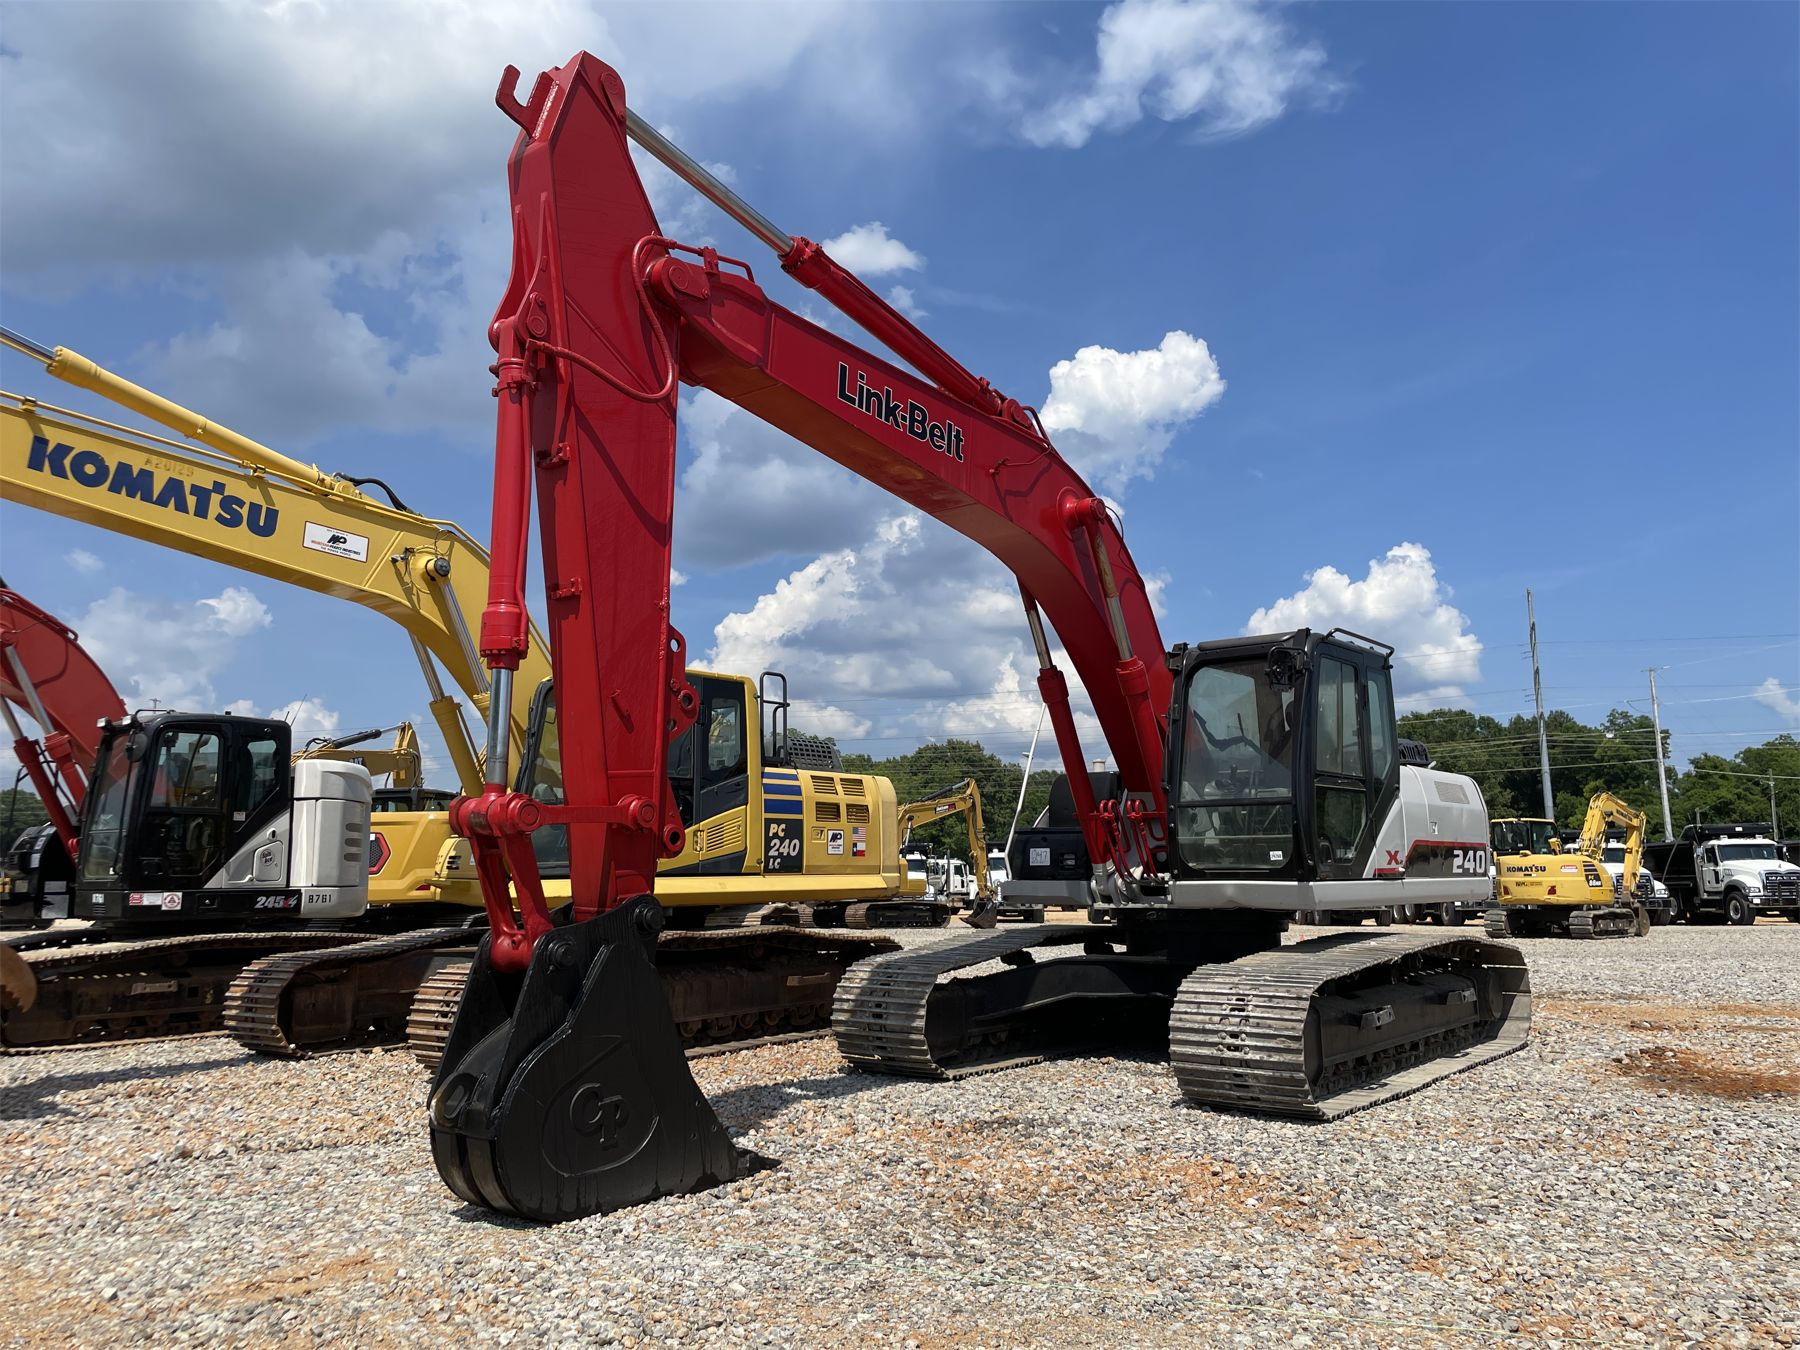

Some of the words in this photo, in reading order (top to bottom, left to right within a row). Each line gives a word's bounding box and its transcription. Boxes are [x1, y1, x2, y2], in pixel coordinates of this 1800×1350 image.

[837, 361, 965, 462] Link-Belt
[27, 435, 280, 538] KOMATSU
[768, 824, 786, 837] PC
[768, 839, 800, 857] 240
[768, 858, 781, 870] LC
[1452, 849, 1486, 874] 240
[1507, 864, 1546, 873] KOMATSU
